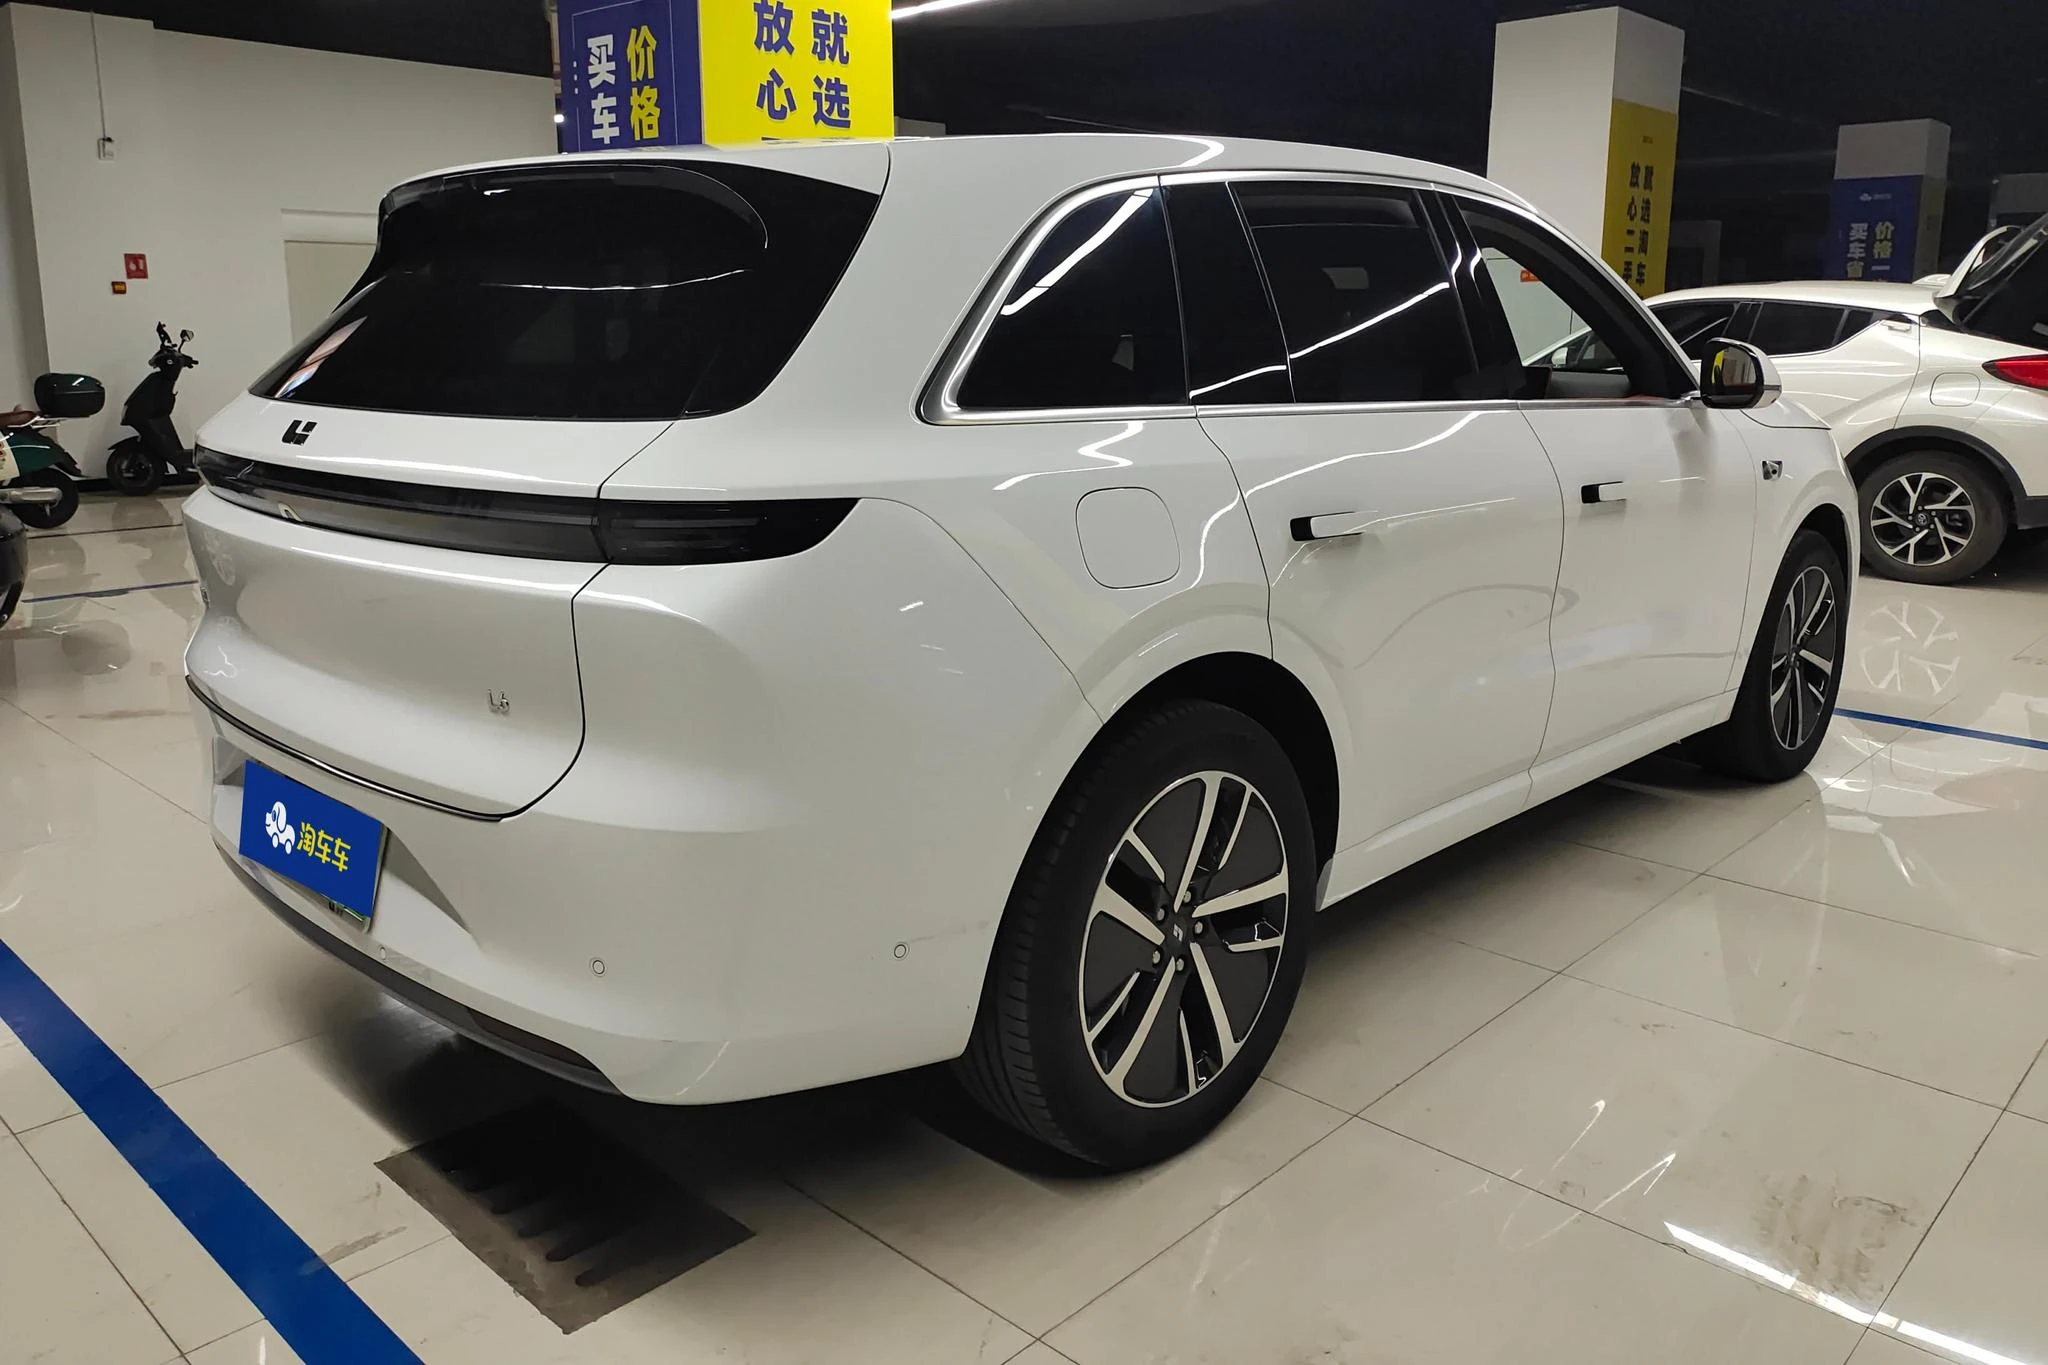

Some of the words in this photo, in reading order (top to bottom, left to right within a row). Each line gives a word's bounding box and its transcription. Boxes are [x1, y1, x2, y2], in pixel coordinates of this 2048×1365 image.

[587, 34, 620, 144] 买车
[626, 25, 661, 141] 价格
[753, 0, 797, 140] 放心
[811, 8, 851, 129] 就选
[1871, 221, 1895, 281] 价格一
[297, 822, 351, 872] 淘车车
